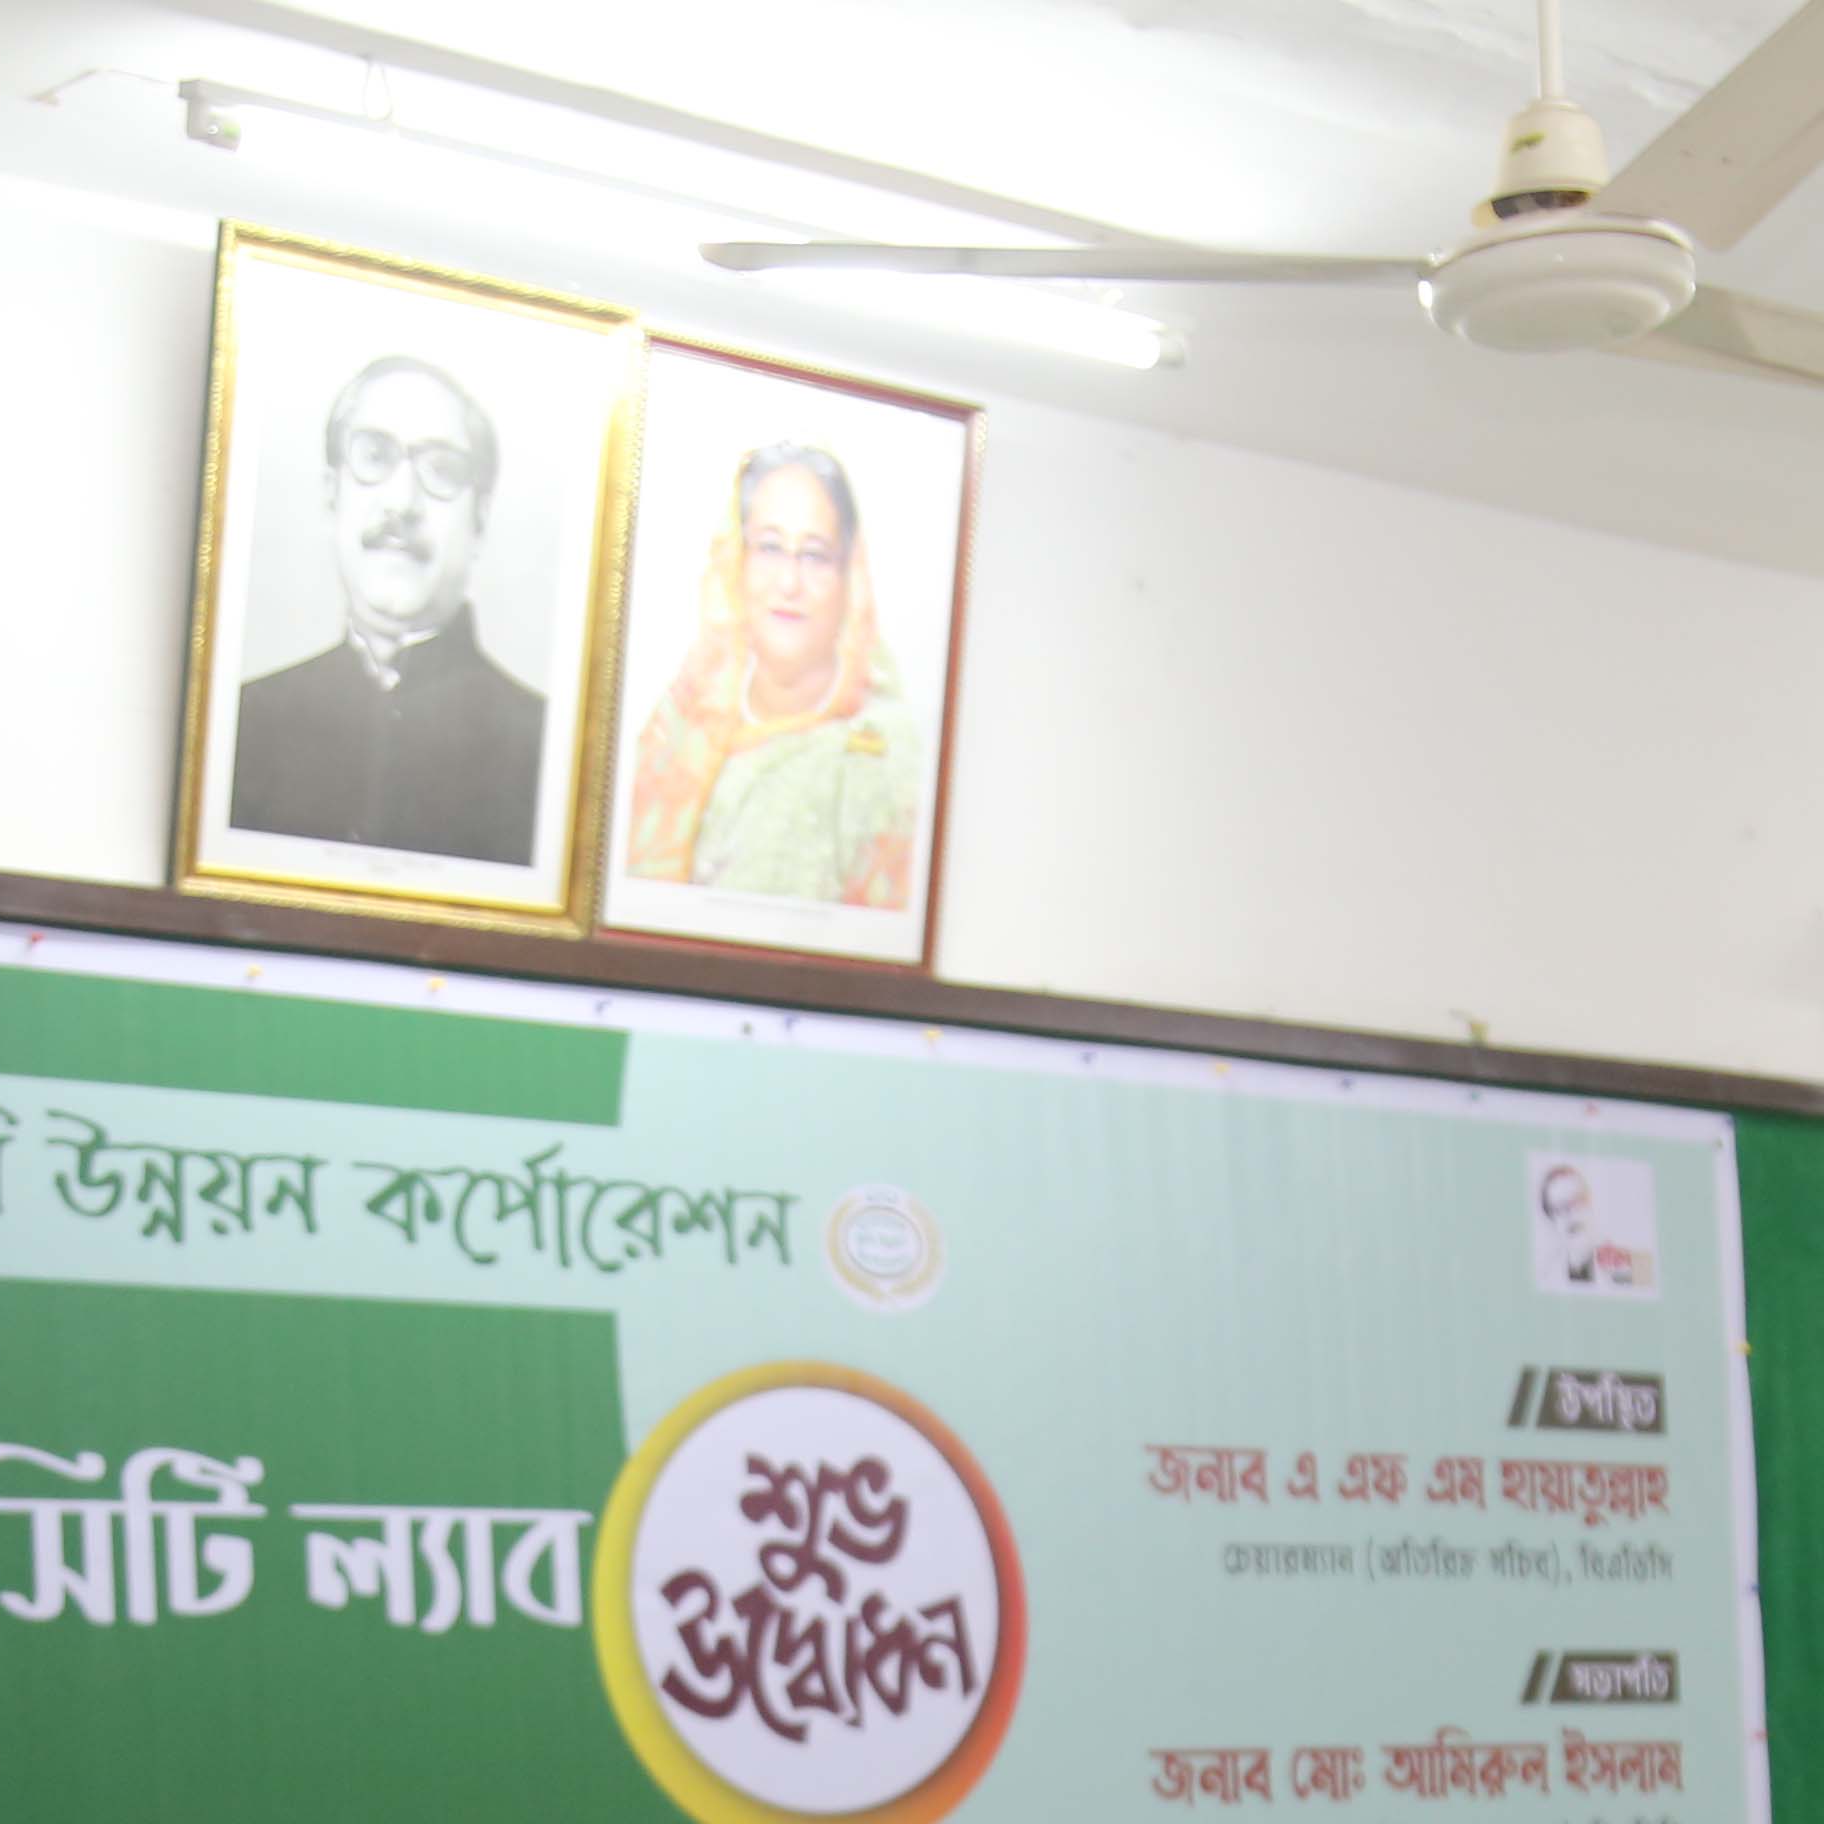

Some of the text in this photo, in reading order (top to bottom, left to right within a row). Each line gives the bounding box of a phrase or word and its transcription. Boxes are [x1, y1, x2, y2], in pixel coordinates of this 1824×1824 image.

[46, 1109, 329, 1247] উন্নয়ন
[352, 1141, 800, 1274] কর্পোরেশন
[739, 1452, 909, 1606] শুভ
[1144, 1444, 1269, 1502] জনাব
[1286, 1451, 1319, 1500] এ
[1338, 1453, 1408, 1502] এফ
[1426, 1456, 1487, 1510] এম
[290, 1503, 592, 1634] ল্যাব
[659, 1567, 977, 1744] উদ্বোধন
[1148, 1747, 1273, 1804] জনাব
[1381, 1726, 1550, 1800] আমিরুল
[1561, 1726, 1684, 1794] ইসলাম
